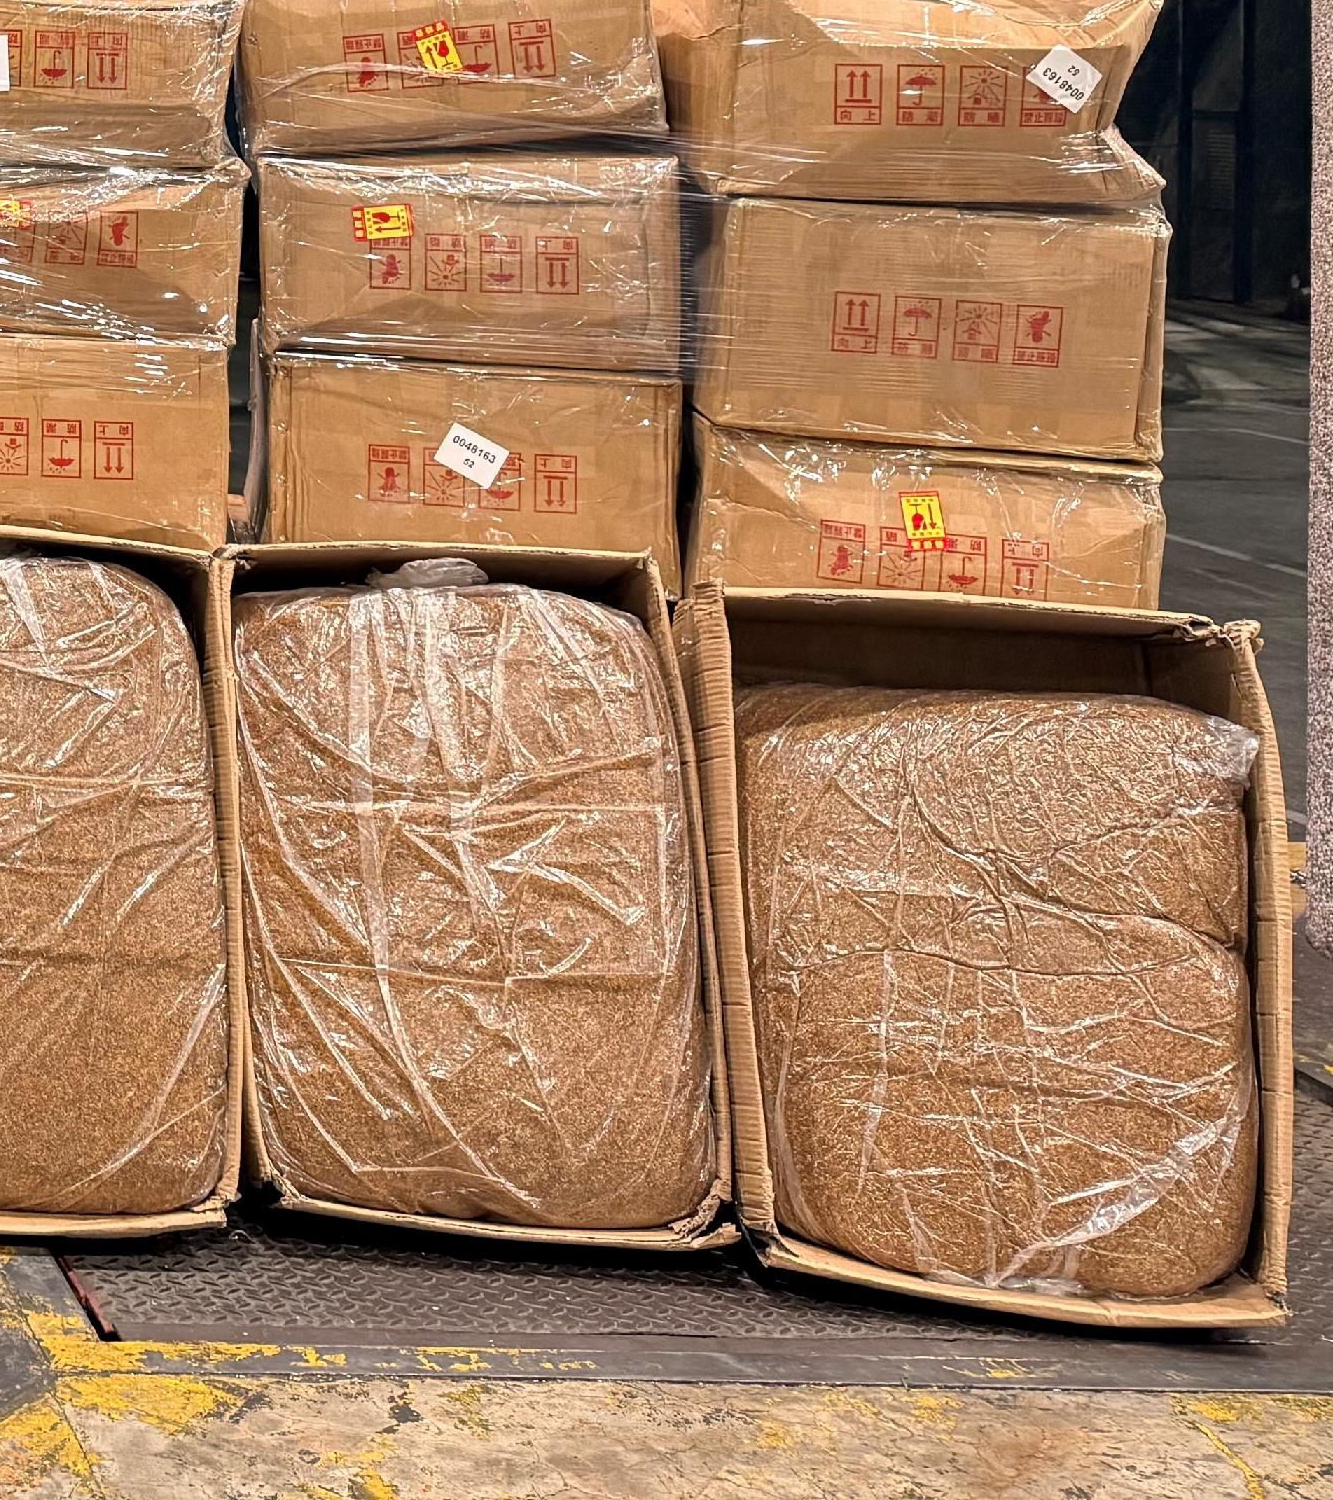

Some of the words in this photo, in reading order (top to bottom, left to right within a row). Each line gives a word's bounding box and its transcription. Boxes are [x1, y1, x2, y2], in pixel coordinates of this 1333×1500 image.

[512, 23, 546, 36] 向上
[1042, 67, 1084, 101] 0048163
[841, 110, 877, 121] 向上
[46, 422, 77, 434] 防潮
[99, 425, 129, 436] 向上
[453, 435, 496, 463] 0048163
[538, 457, 572, 469] 向上
